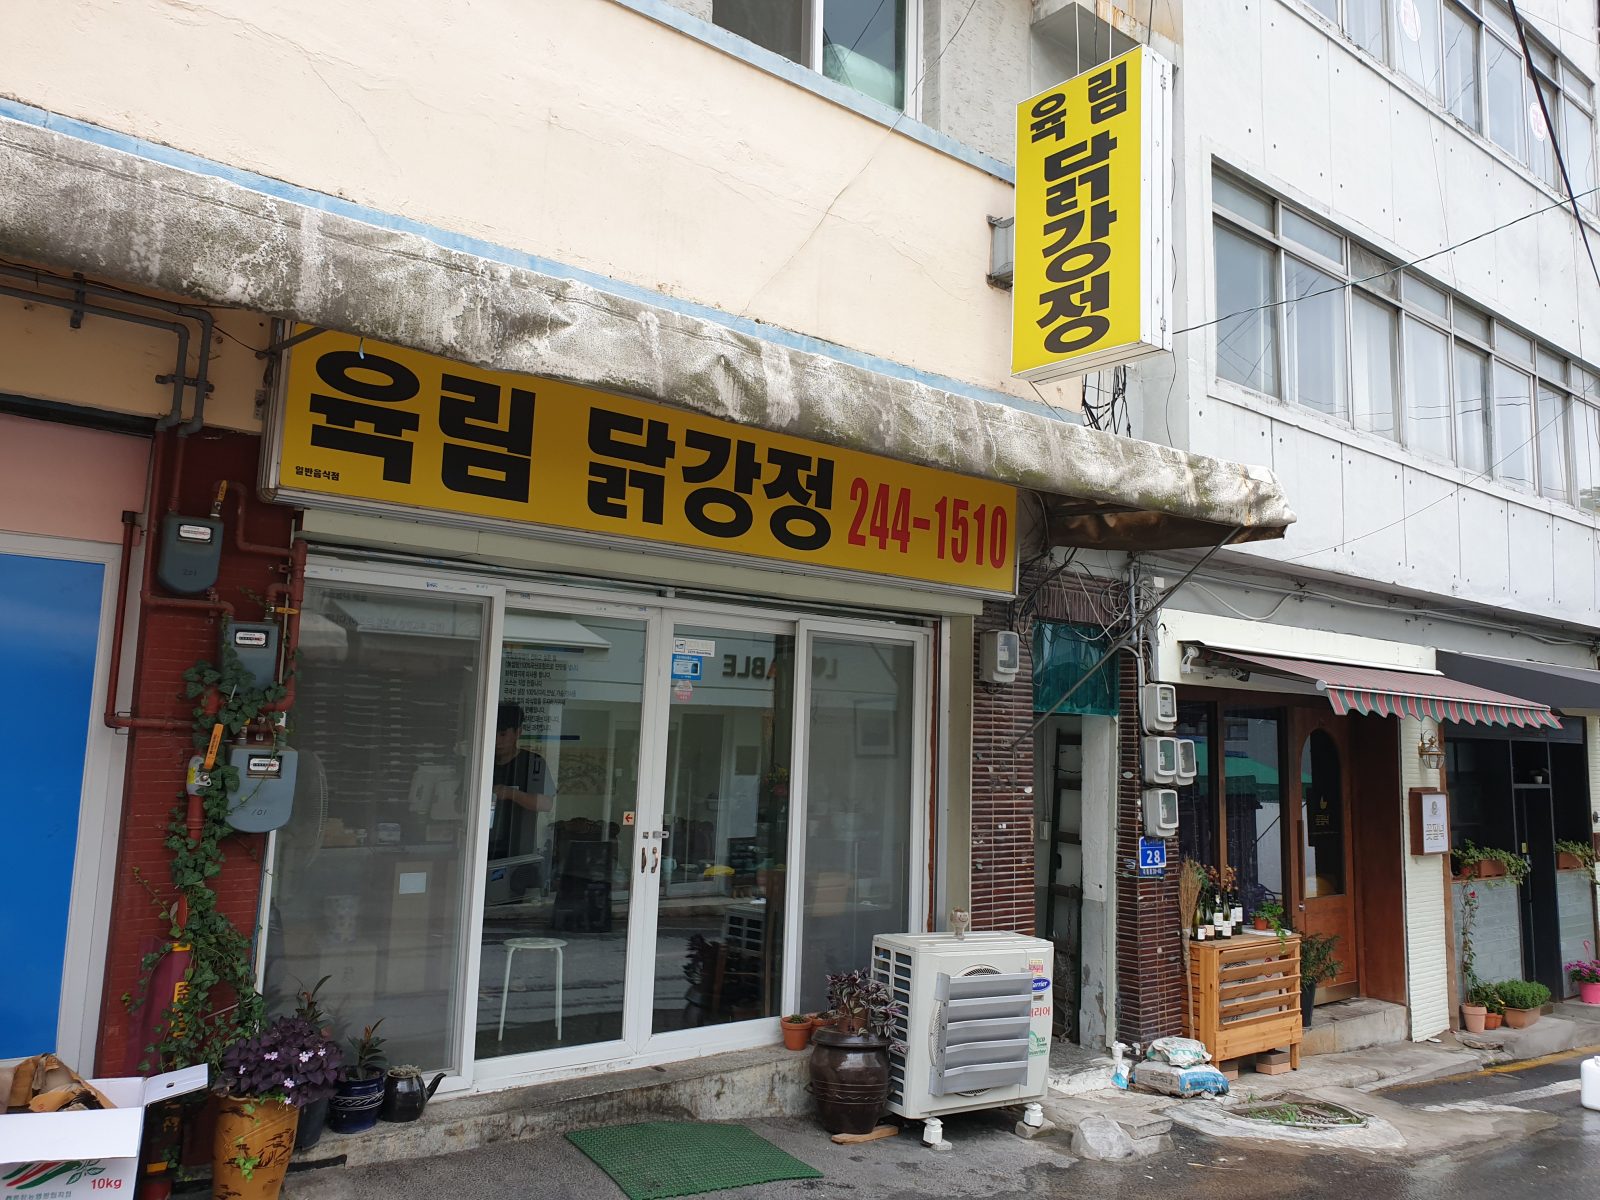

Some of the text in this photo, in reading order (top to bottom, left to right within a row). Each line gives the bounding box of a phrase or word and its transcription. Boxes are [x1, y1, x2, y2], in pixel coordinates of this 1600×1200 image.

[1030, 60, 1127, 144] 육림
[1036, 129, 1117, 354] 닭강정
[295, 465, 340, 481] 일반음식점
[309, 350, 1007, 569] 육림 닭강정 244-1510
[1146, 850, 1161, 864] 28
[91, 1178, 123, 1190] 10kg
